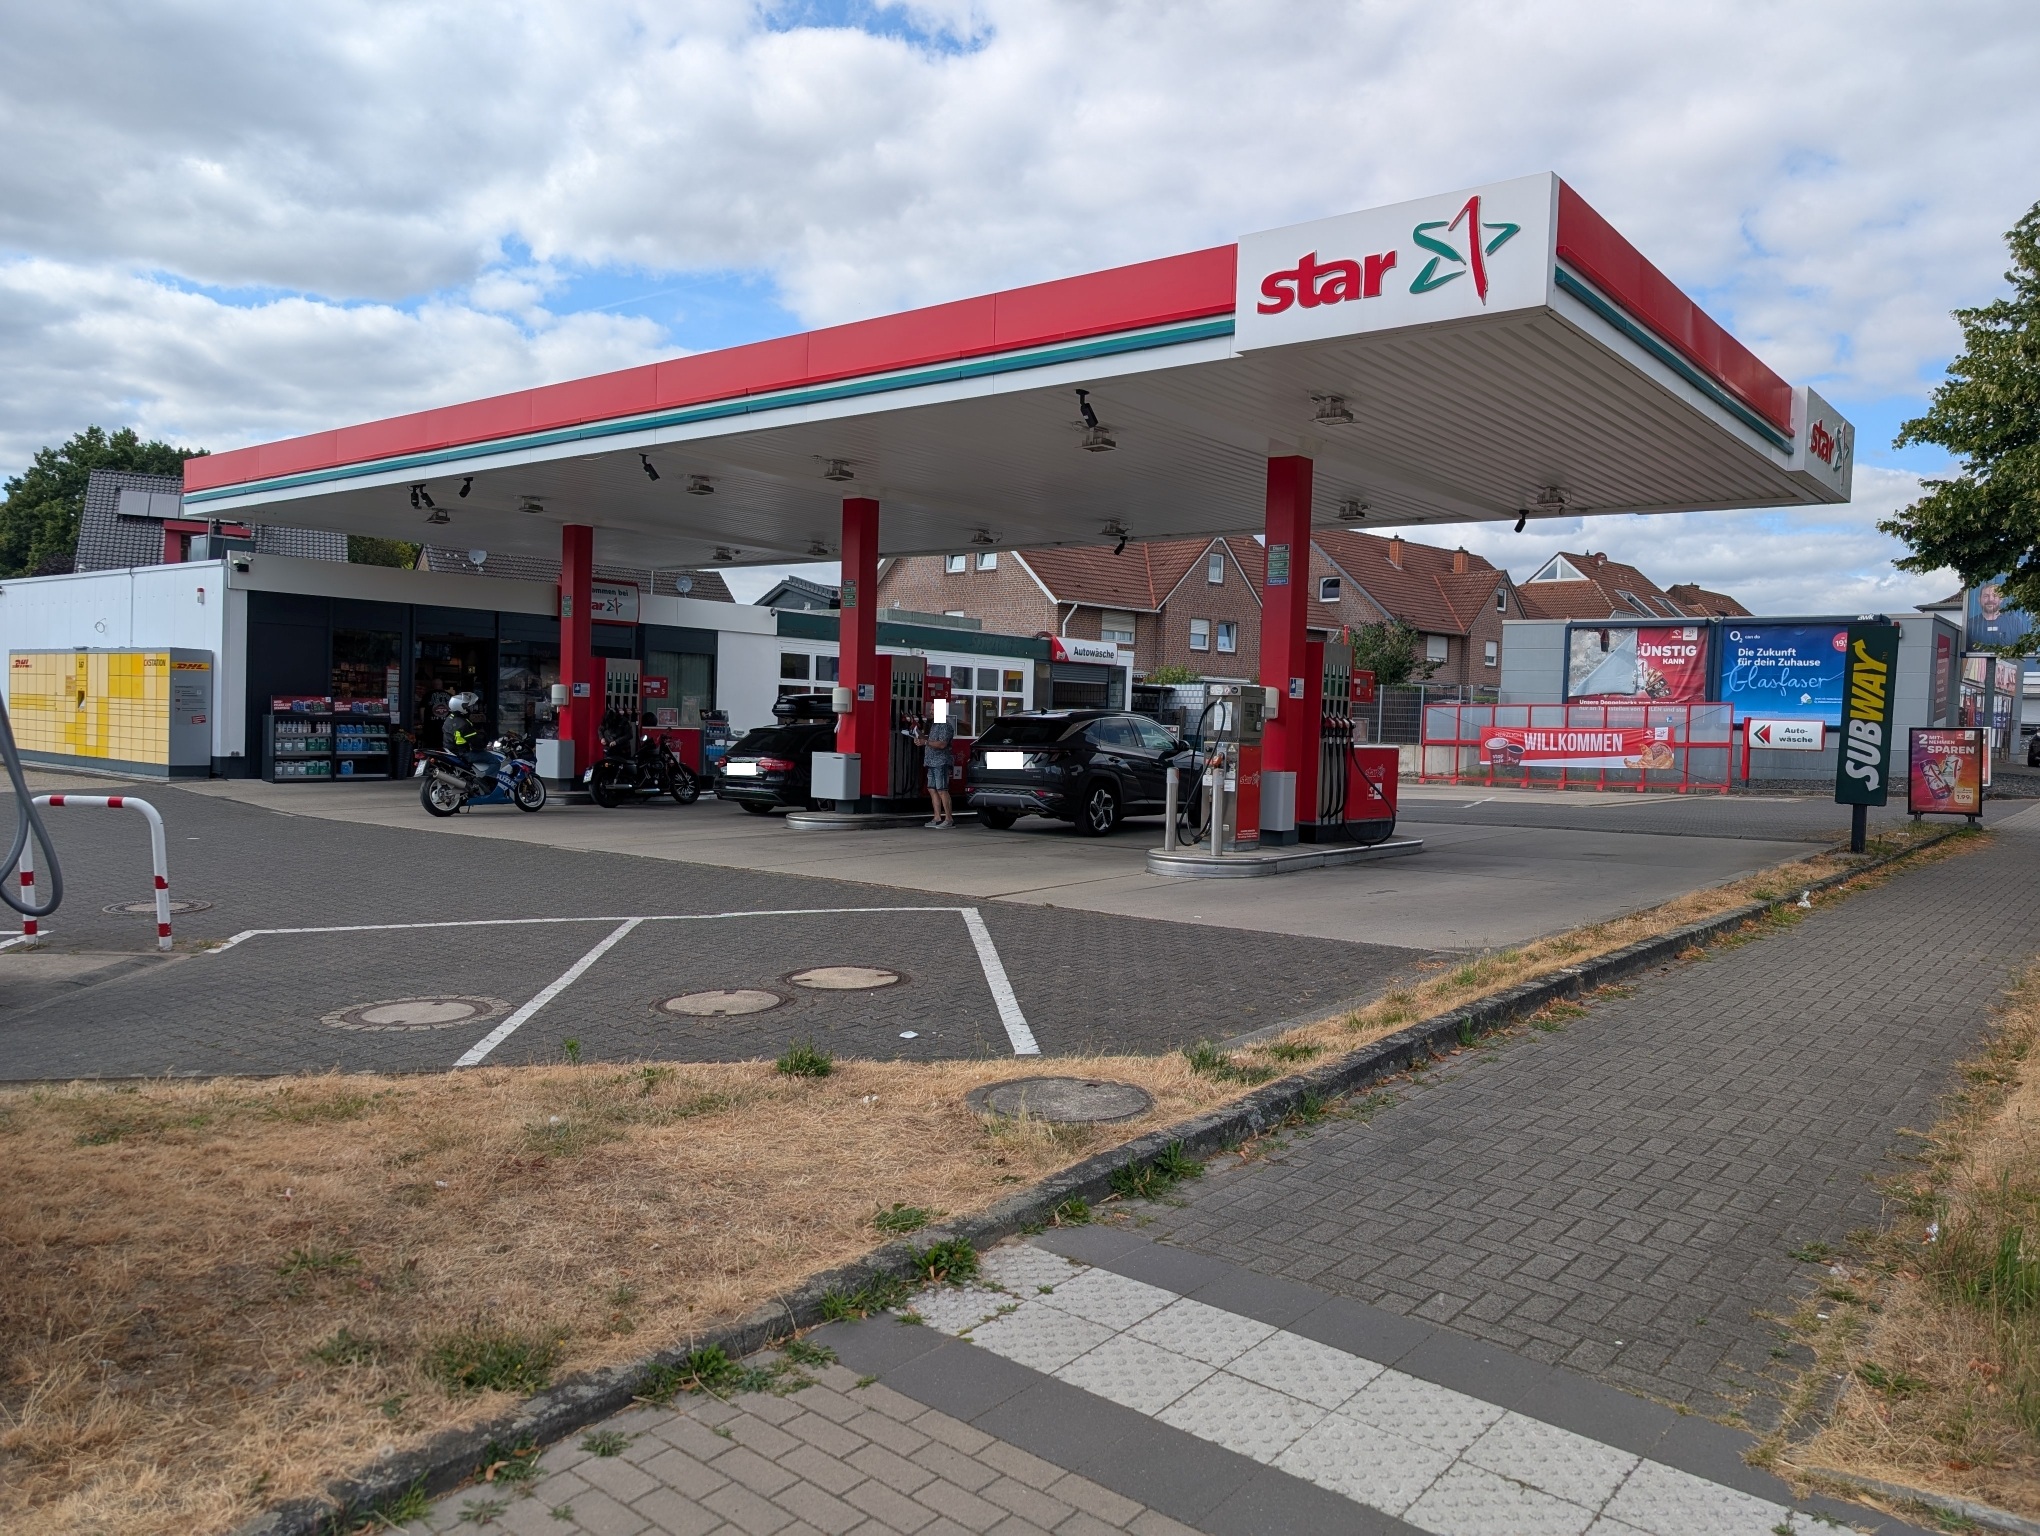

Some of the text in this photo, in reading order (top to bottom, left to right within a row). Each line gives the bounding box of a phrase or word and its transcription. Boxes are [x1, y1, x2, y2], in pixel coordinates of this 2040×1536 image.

[1257, 250, 1397, 315] star
[1809, 418, 1835, 465] star
[1857, 612, 1875, 621] awk
[1073, 646, 1115, 659] Autowäsche
[1738, 648, 1797, 657] Die Zukunft
[1738, 657, 1821, 667] für dein Zuhause
[1728, 665, 1829, 697] Glasfaser
[1845, 639, 1888, 791] SUBWAY
[1524, 733, 1623, 752] WILLKOMMEN
[1919, 734, 1928, 745] 2
[1927, 745, 1975, 754] SPAREN
